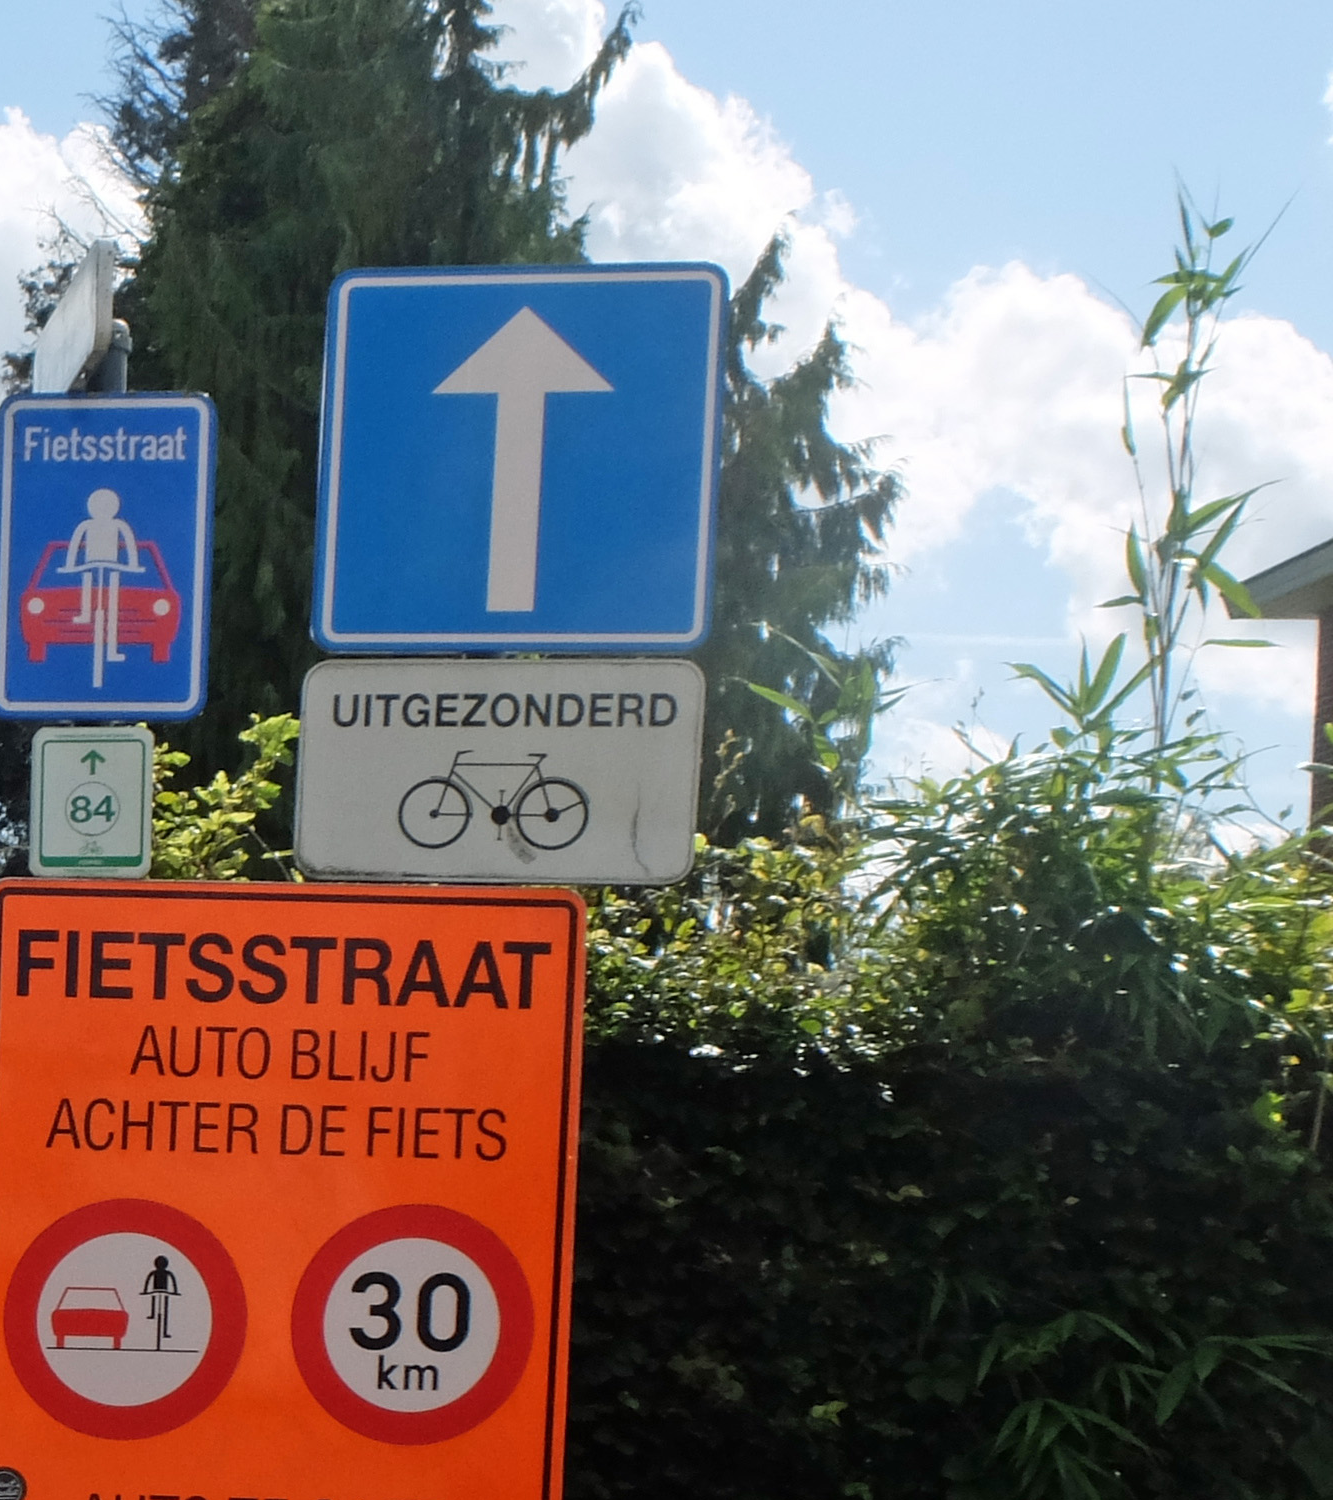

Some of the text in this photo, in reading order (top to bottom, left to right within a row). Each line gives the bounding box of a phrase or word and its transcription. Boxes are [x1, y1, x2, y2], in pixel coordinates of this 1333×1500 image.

[23, 426, 187, 462] Fietsstraat
[332, 692, 678, 728] UITGEZONDERD
[70, 795, 116, 823] 84
[17, 929, 552, 1009] FIETSSTRAAT
[130, 1025, 430, 1083] AUTO BLIJF
[45, 1097, 507, 1162] ACHTER DE FIETS
[348, 1271, 471, 1352] 30
[376, 1354, 439, 1391] km
